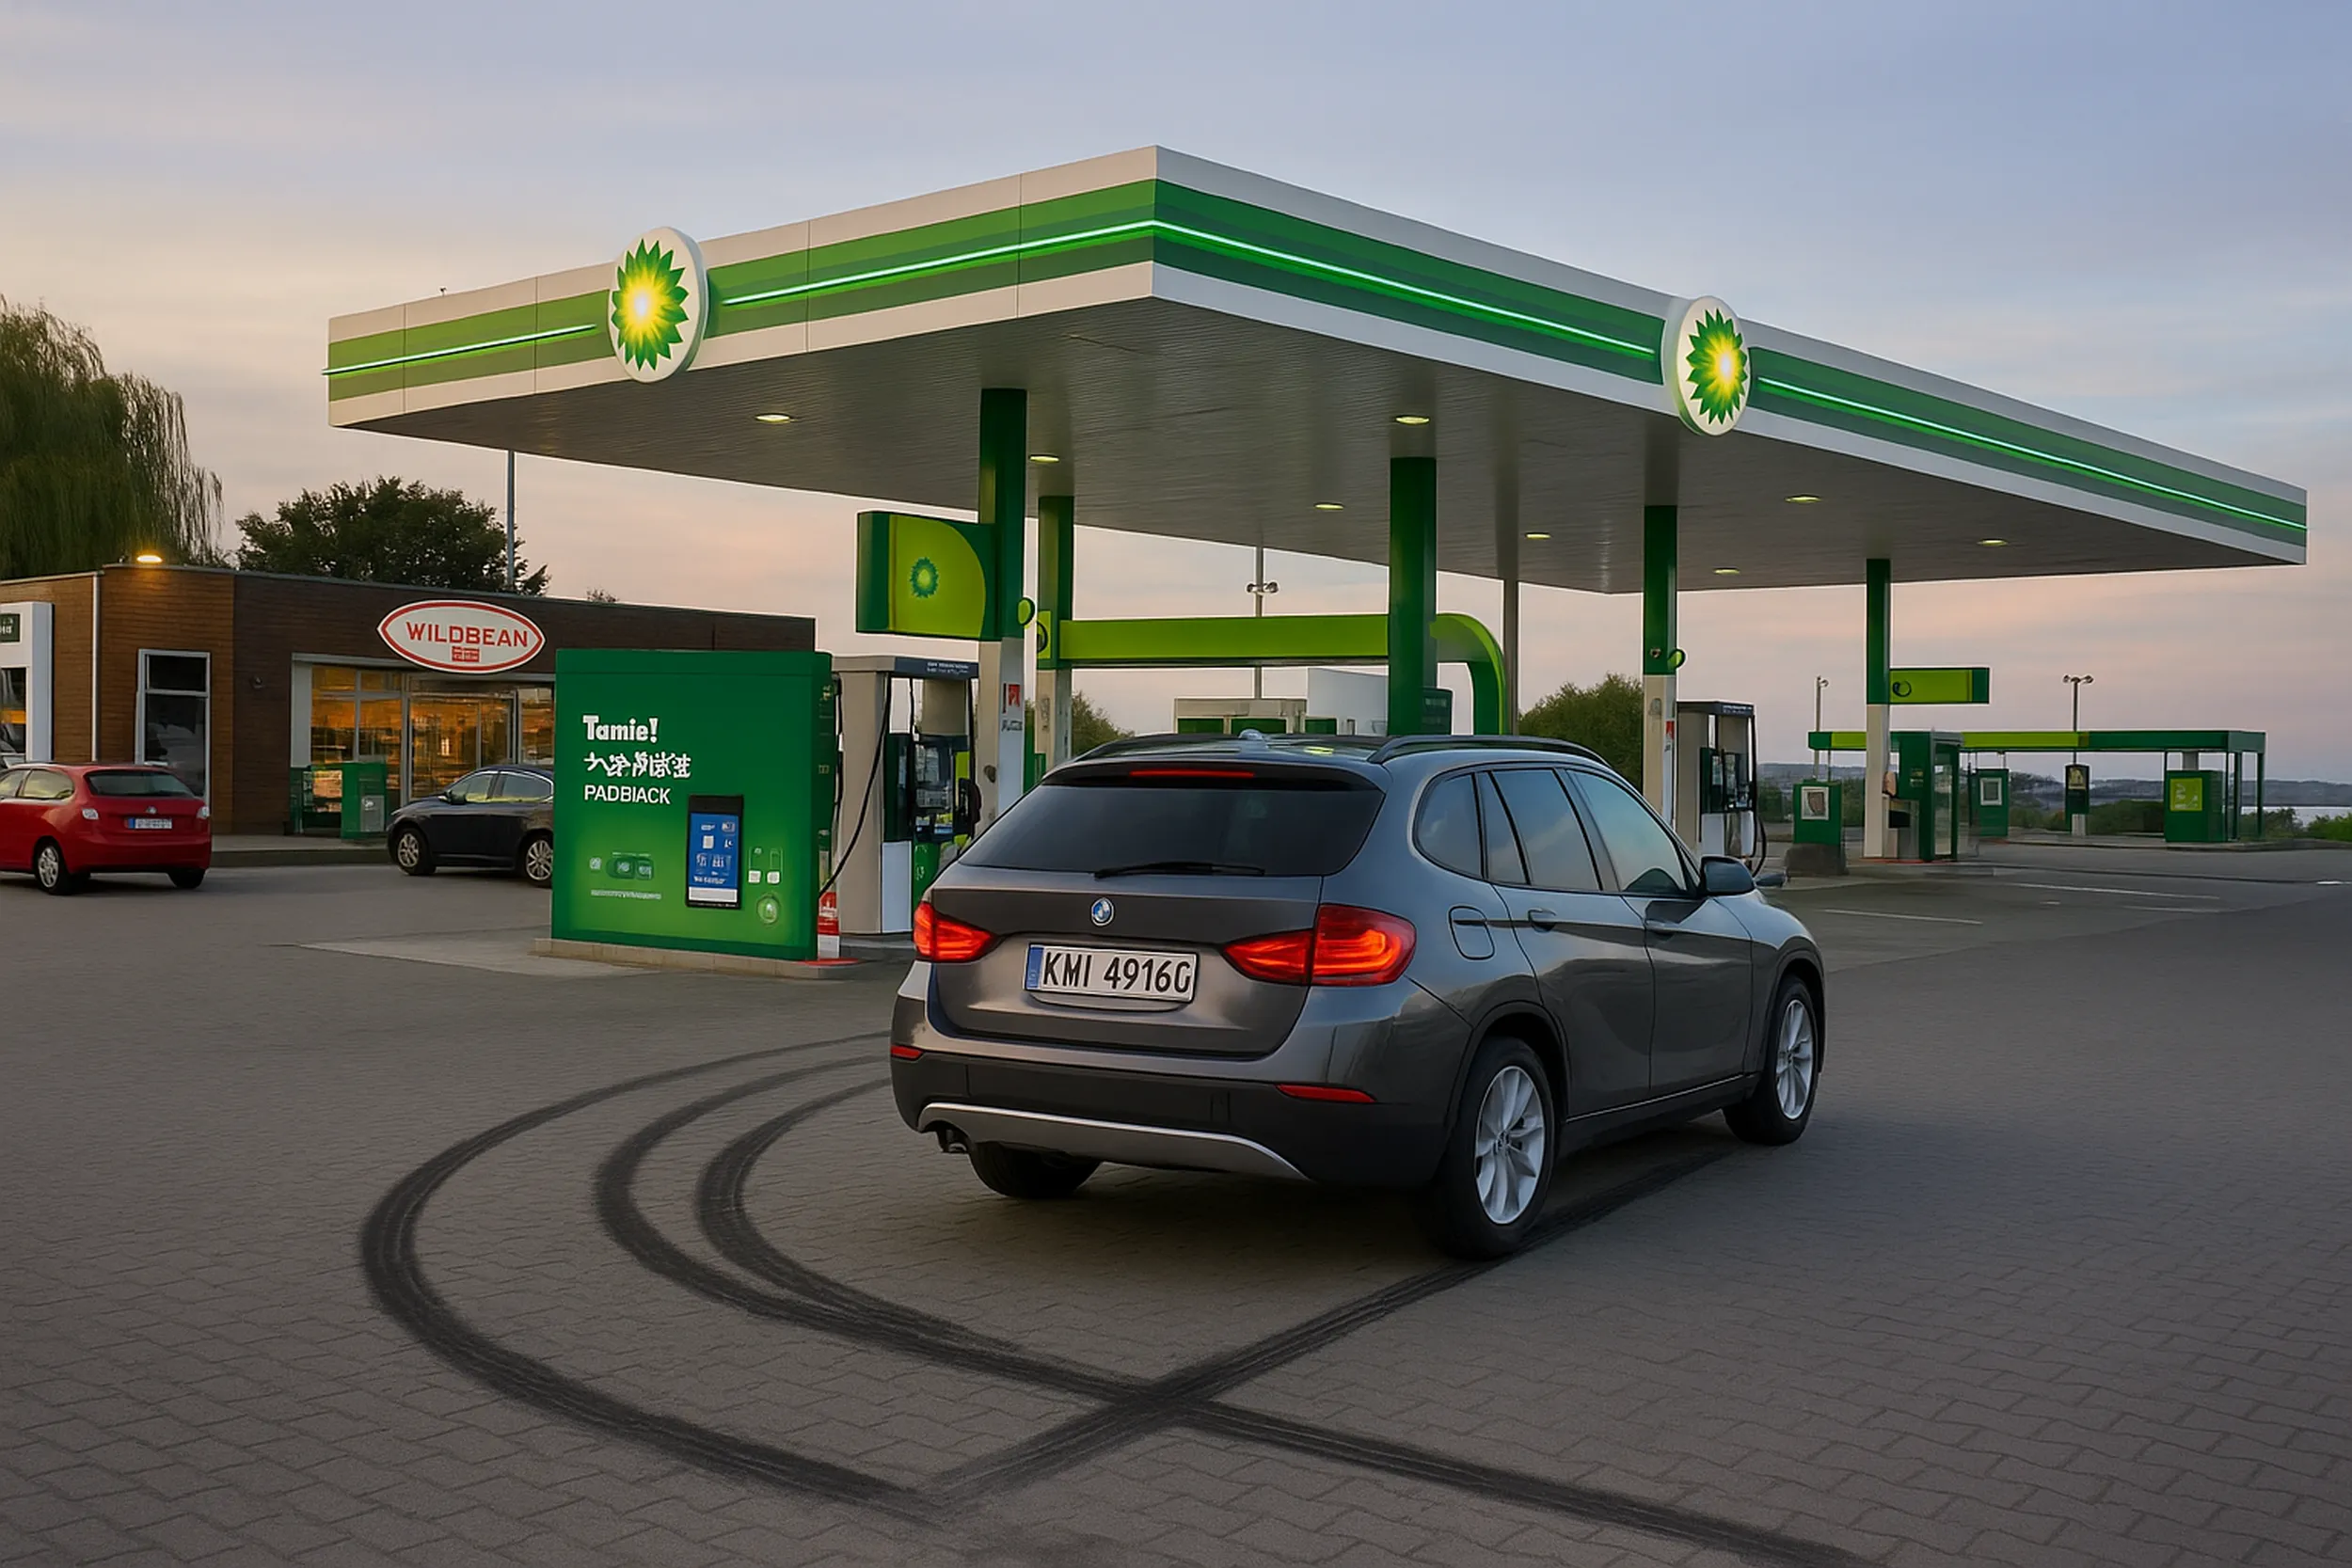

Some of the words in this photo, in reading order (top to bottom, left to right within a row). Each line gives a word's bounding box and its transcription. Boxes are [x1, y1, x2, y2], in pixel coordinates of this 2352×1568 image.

[406, 622, 528, 647] WILDBEAN
[582, 715, 659, 743] Tamie!
[1043, 952, 1092, 988] KMI
[1104, 957, 1191, 993] 4916G
